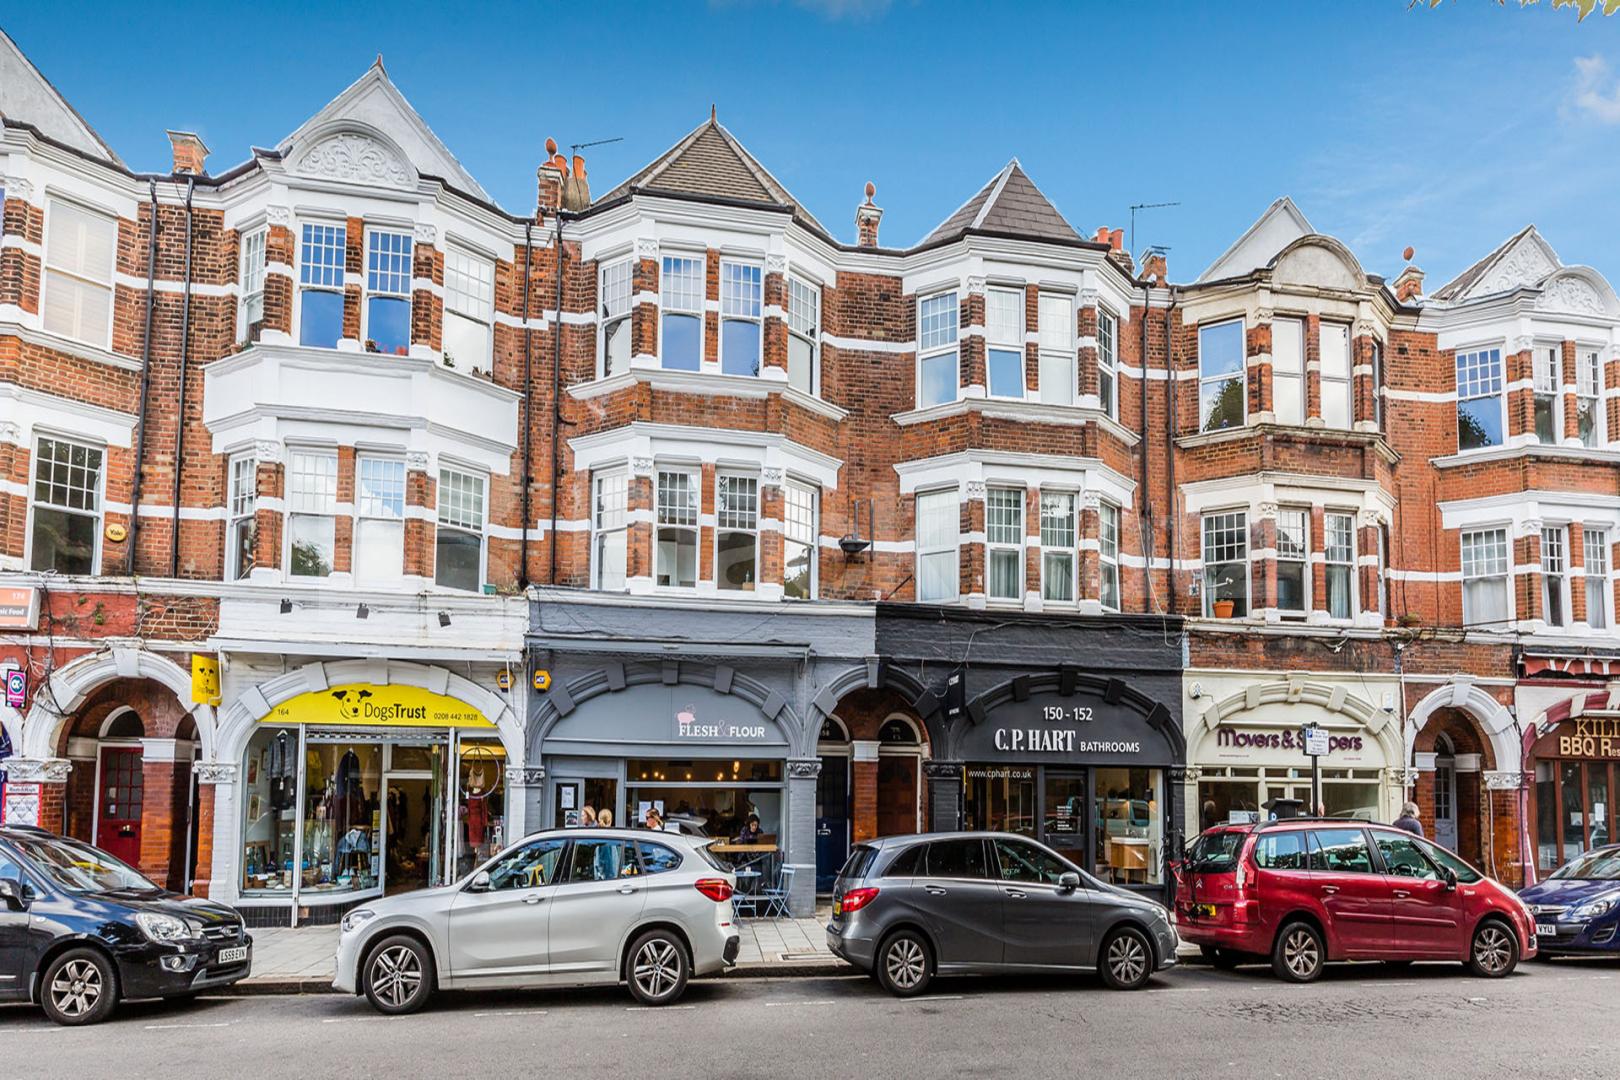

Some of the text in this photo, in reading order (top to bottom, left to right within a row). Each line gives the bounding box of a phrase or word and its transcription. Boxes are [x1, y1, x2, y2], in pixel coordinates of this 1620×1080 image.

[9, 608, 24, 616] Food
[364, 702, 426, 721] DogsTrust
[434, 712, 449, 720] 0208
[450, 713, 462, 721] 442
[1043, 706, 1063, 720] 150
[1073, 707, 1093, 720] 152
[679, 725, 718, 737] FLESH
[729, 726, 765, 737] FLOUR
[1217, 727, 1280, 748] Movers
[1281, 729, 1296, 749] &
[1028, 729, 1076, 751] HART
[1080, 741, 1140, 752] BATHROOMS
[1560, 736, 1595, 757] BBQ
[968, 769, 1031, 780] www.cphart.co.uk
